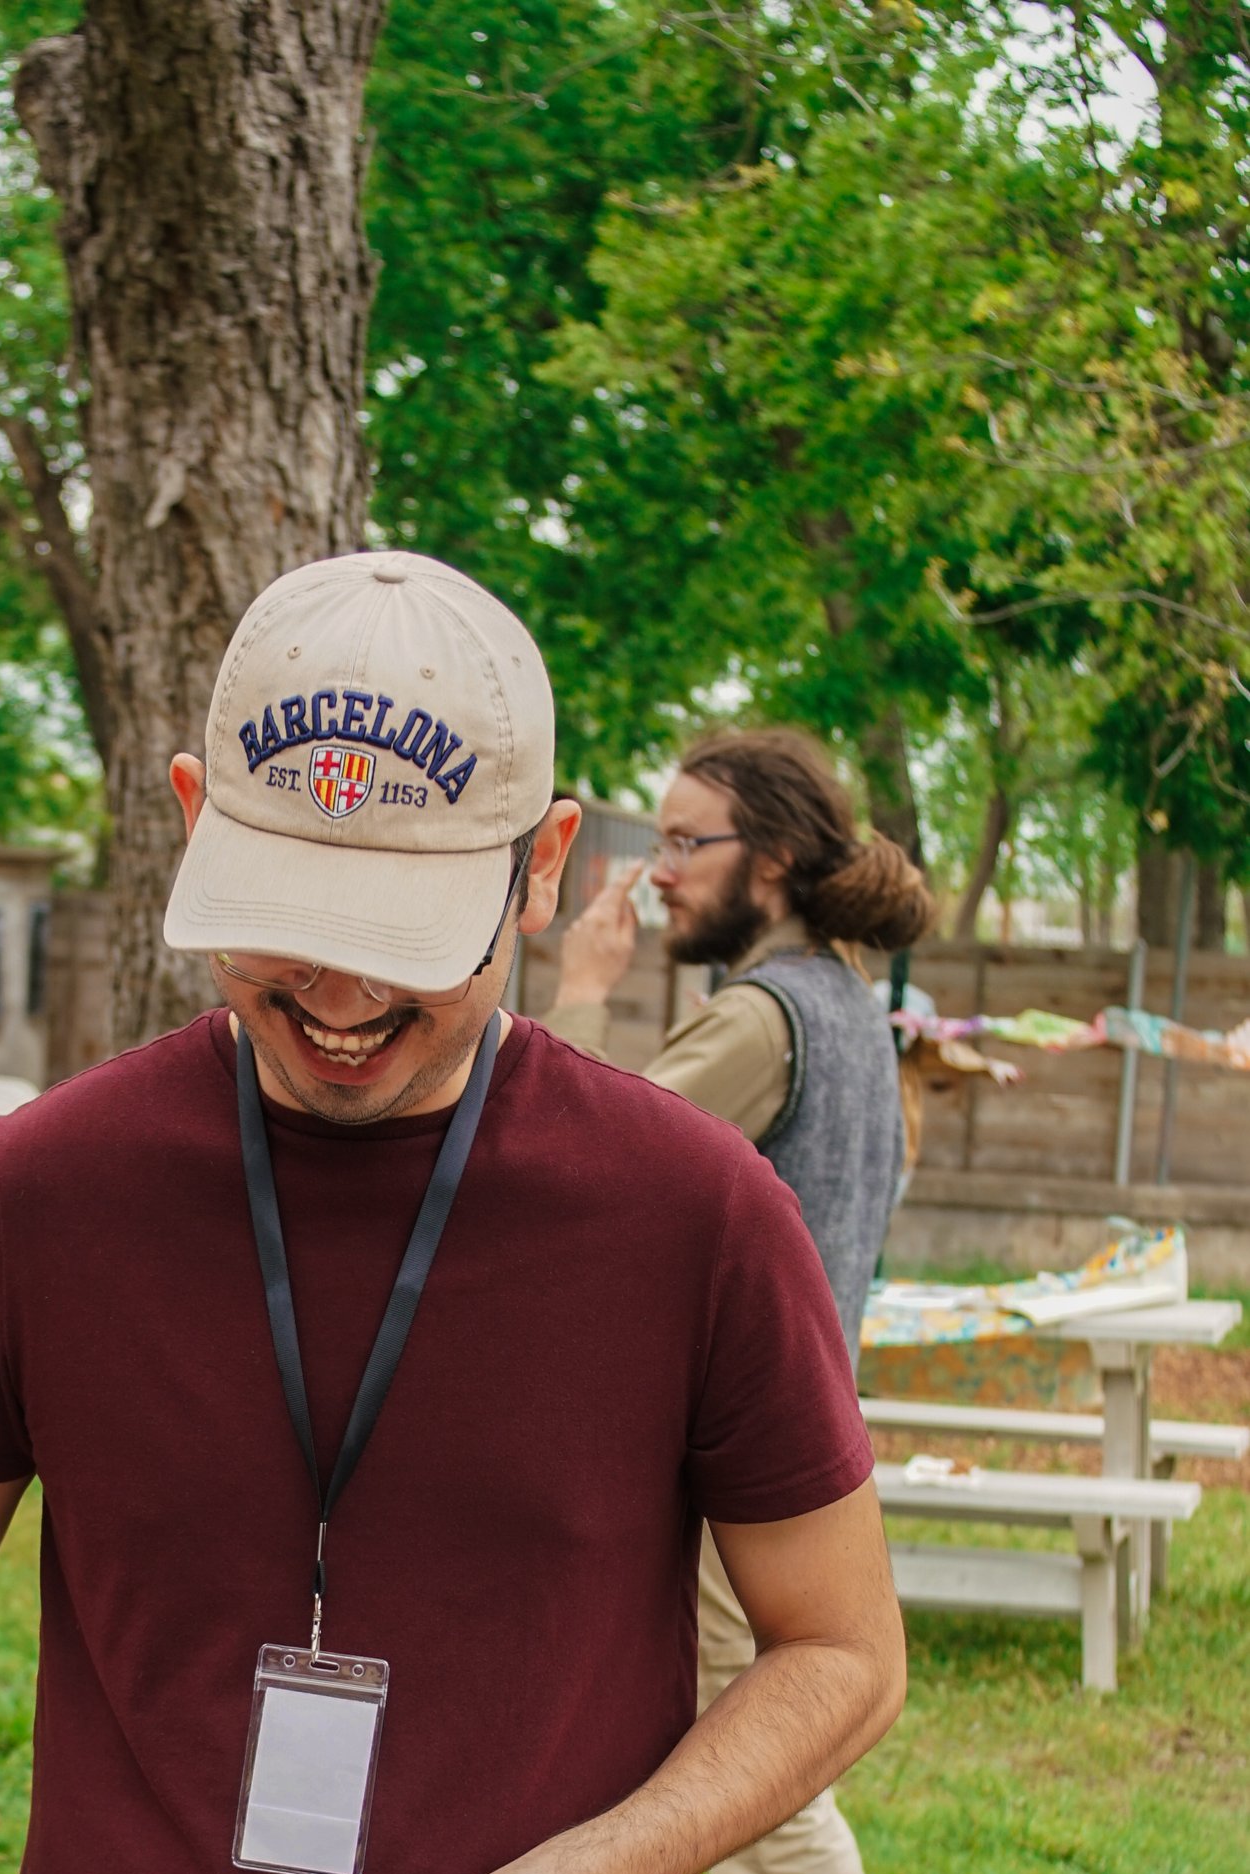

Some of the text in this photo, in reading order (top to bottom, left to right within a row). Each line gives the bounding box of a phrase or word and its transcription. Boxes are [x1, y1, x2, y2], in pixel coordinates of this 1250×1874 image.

[238, 690, 477, 804] BARCELONA
[266, 765, 301, 792] EST.
[378, 781, 428, 808] 1153
